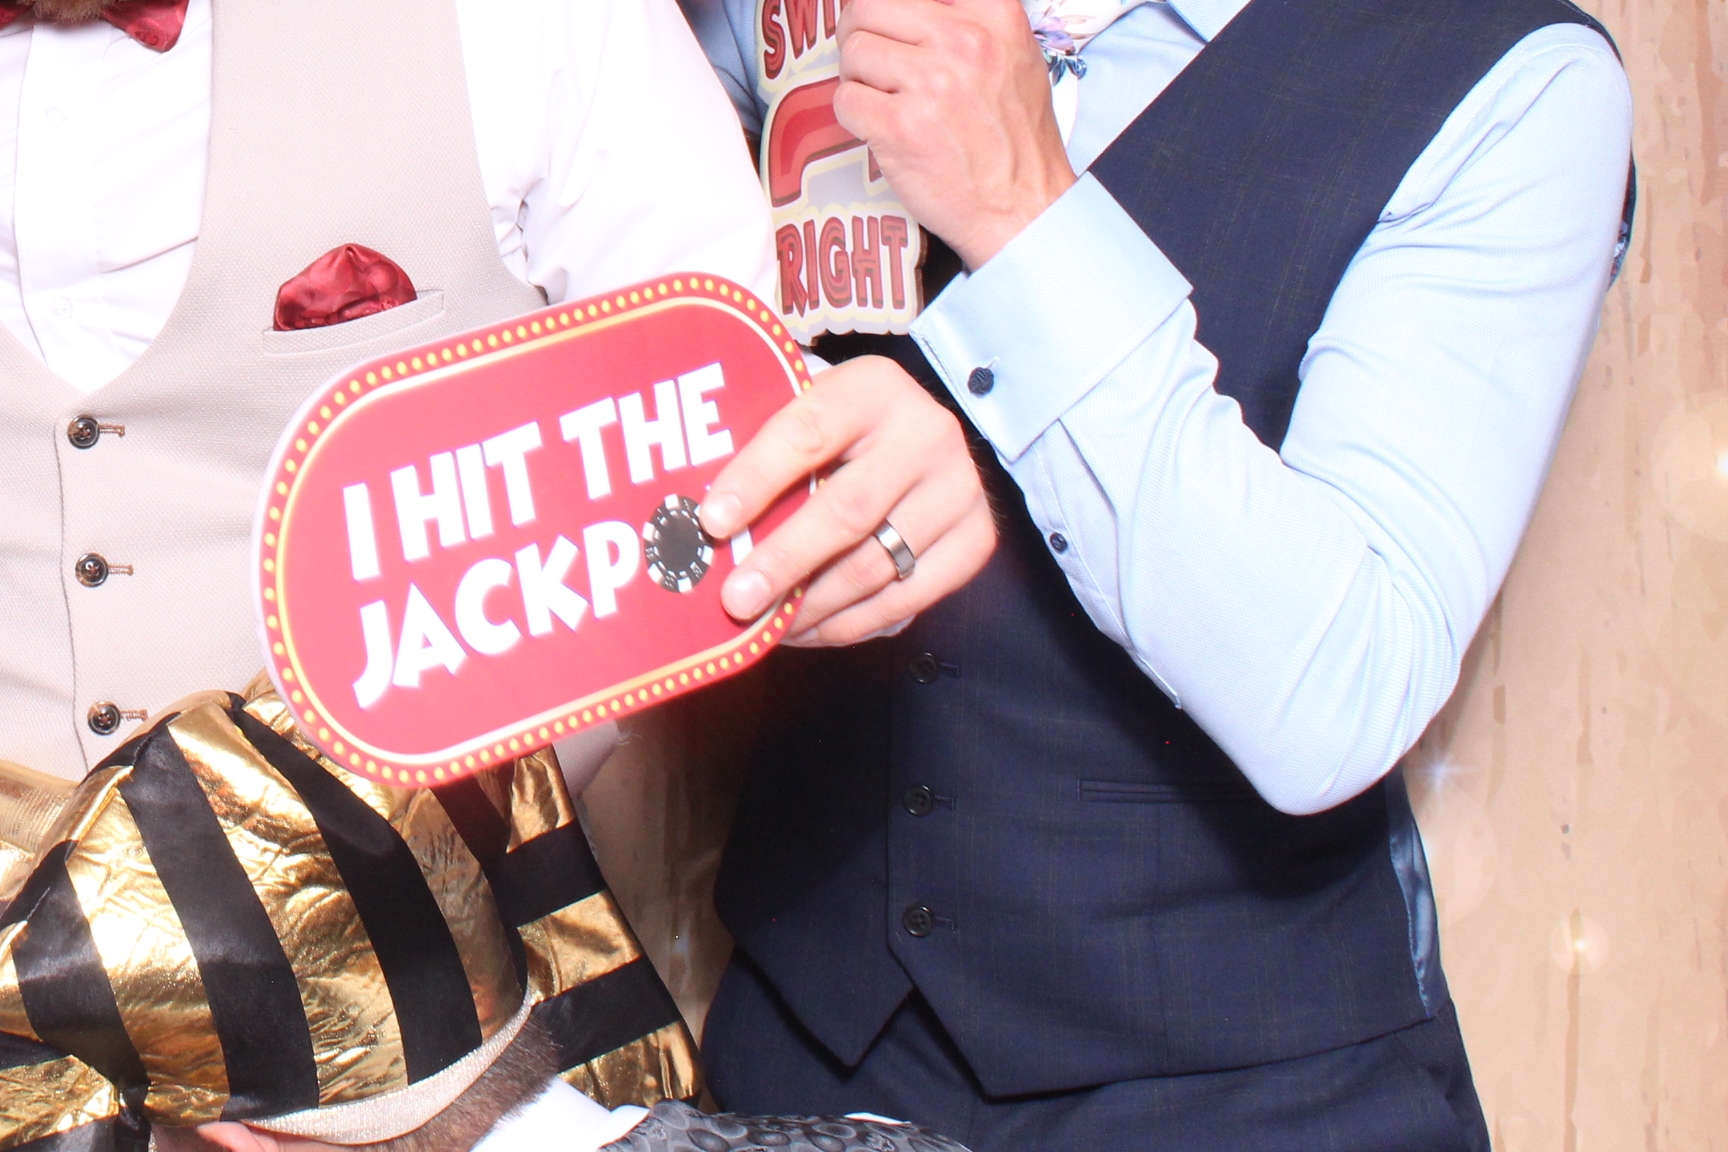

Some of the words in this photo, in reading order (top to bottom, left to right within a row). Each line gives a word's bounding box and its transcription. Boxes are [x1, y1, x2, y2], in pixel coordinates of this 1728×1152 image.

[775, 214, 908, 318] RIGHT
[343, 482, 379, 581] I
[390, 422, 542, 562] HIT
[559, 361, 735, 501] THE
[353, 485, 754, 709] JACKPO
